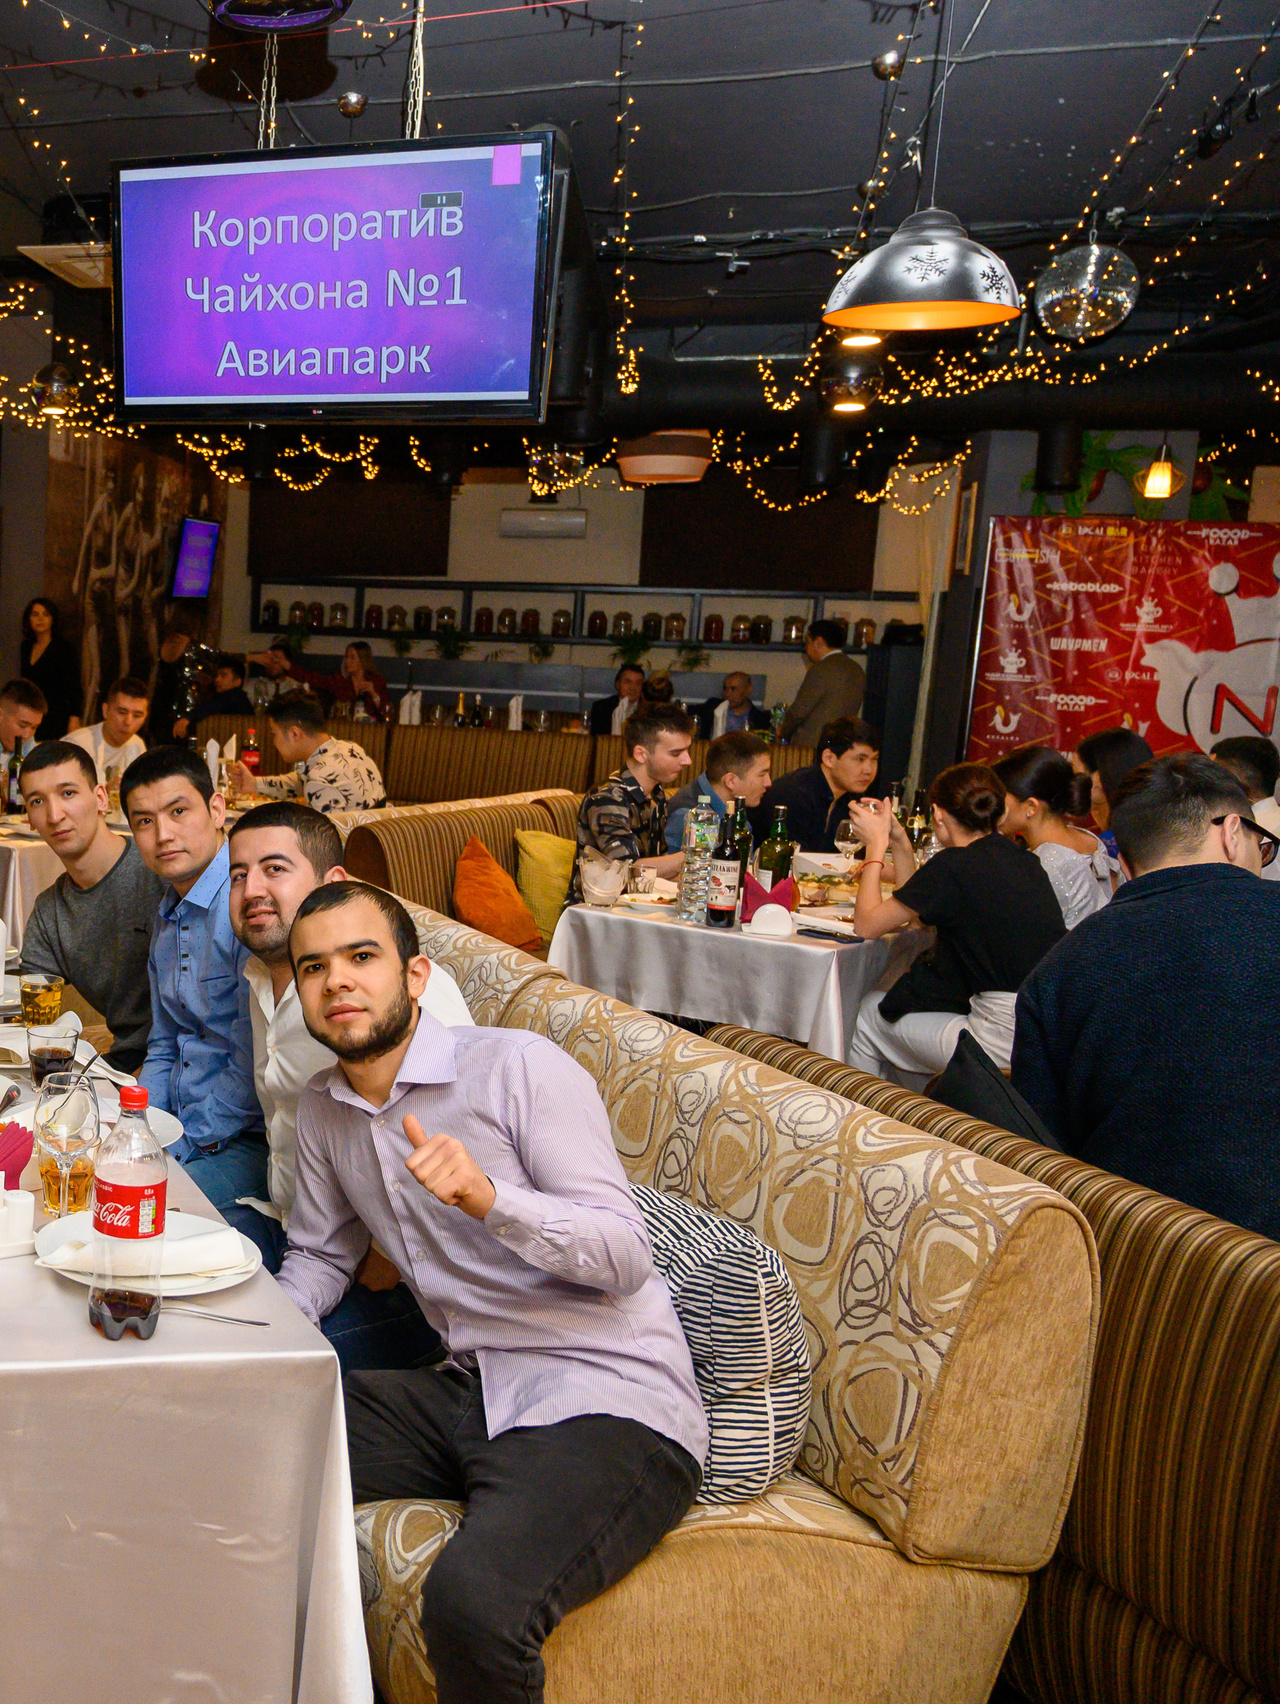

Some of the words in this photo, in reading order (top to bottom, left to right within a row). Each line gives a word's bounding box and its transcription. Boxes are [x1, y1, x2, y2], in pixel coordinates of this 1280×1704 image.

[192, 207, 464, 254] Корпоратив
[185, 272, 369, 314] Чайхона
[386, 266, 468, 307] №1
[216, 340, 432, 383] Авиапарк
